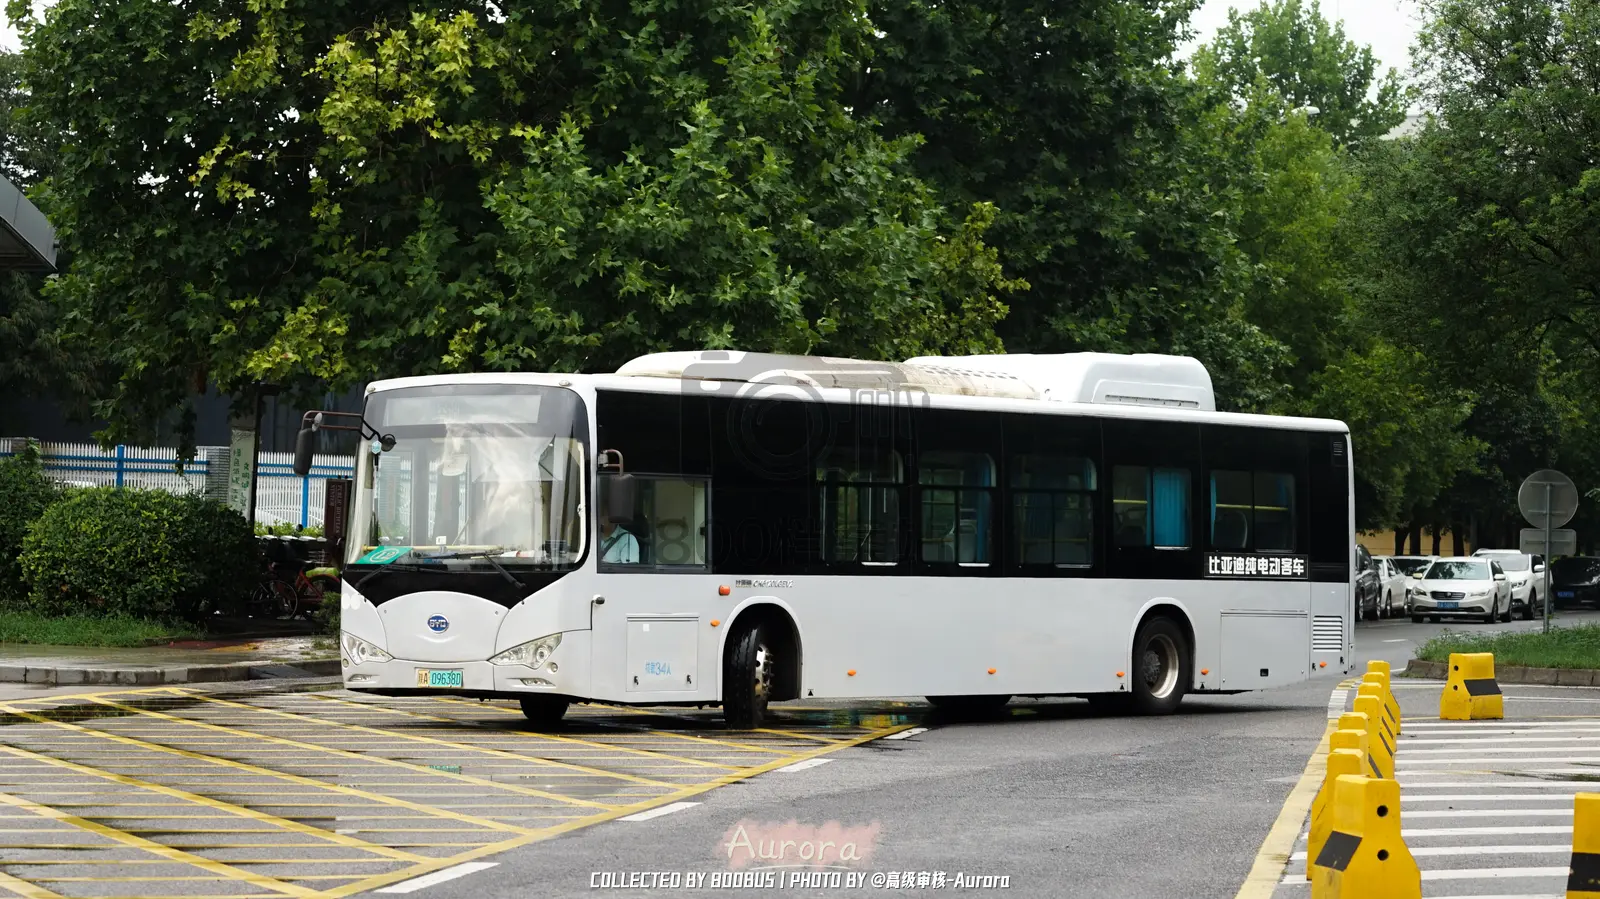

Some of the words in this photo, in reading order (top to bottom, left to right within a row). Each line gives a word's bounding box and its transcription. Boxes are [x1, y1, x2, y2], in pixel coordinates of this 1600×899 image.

[1208, 555, 1305, 576] 比亚迪纯电动客车
